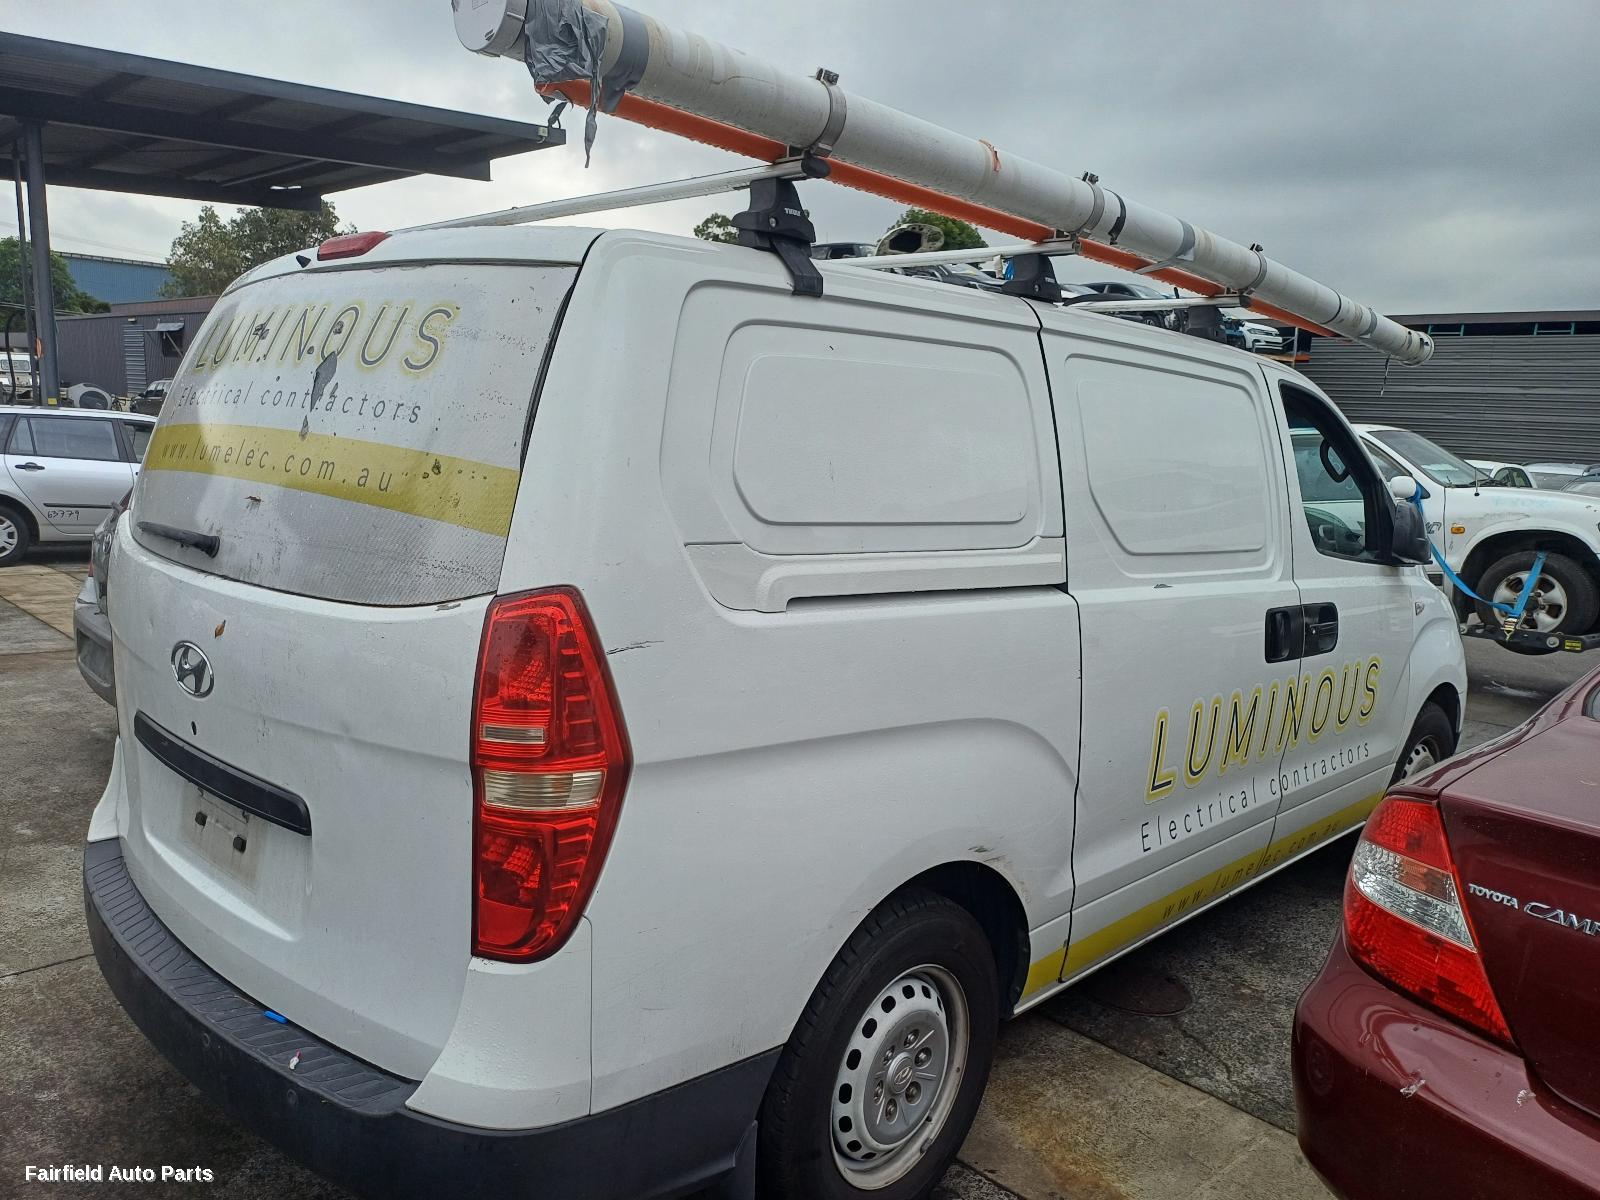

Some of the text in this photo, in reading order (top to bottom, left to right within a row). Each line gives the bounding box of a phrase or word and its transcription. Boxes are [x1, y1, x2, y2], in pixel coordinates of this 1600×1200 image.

[195, 305, 453, 371] LUMINOUS
[178, 380, 253, 407] Electrical
[161, 438, 393, 493] www.lumelec.com.au
[1150, 661, 1379, 793] LUMINOUS
[1140, 740, 1370, 853] Electrical contractors
[1468, 883, 1519, 910] TOYOTA
